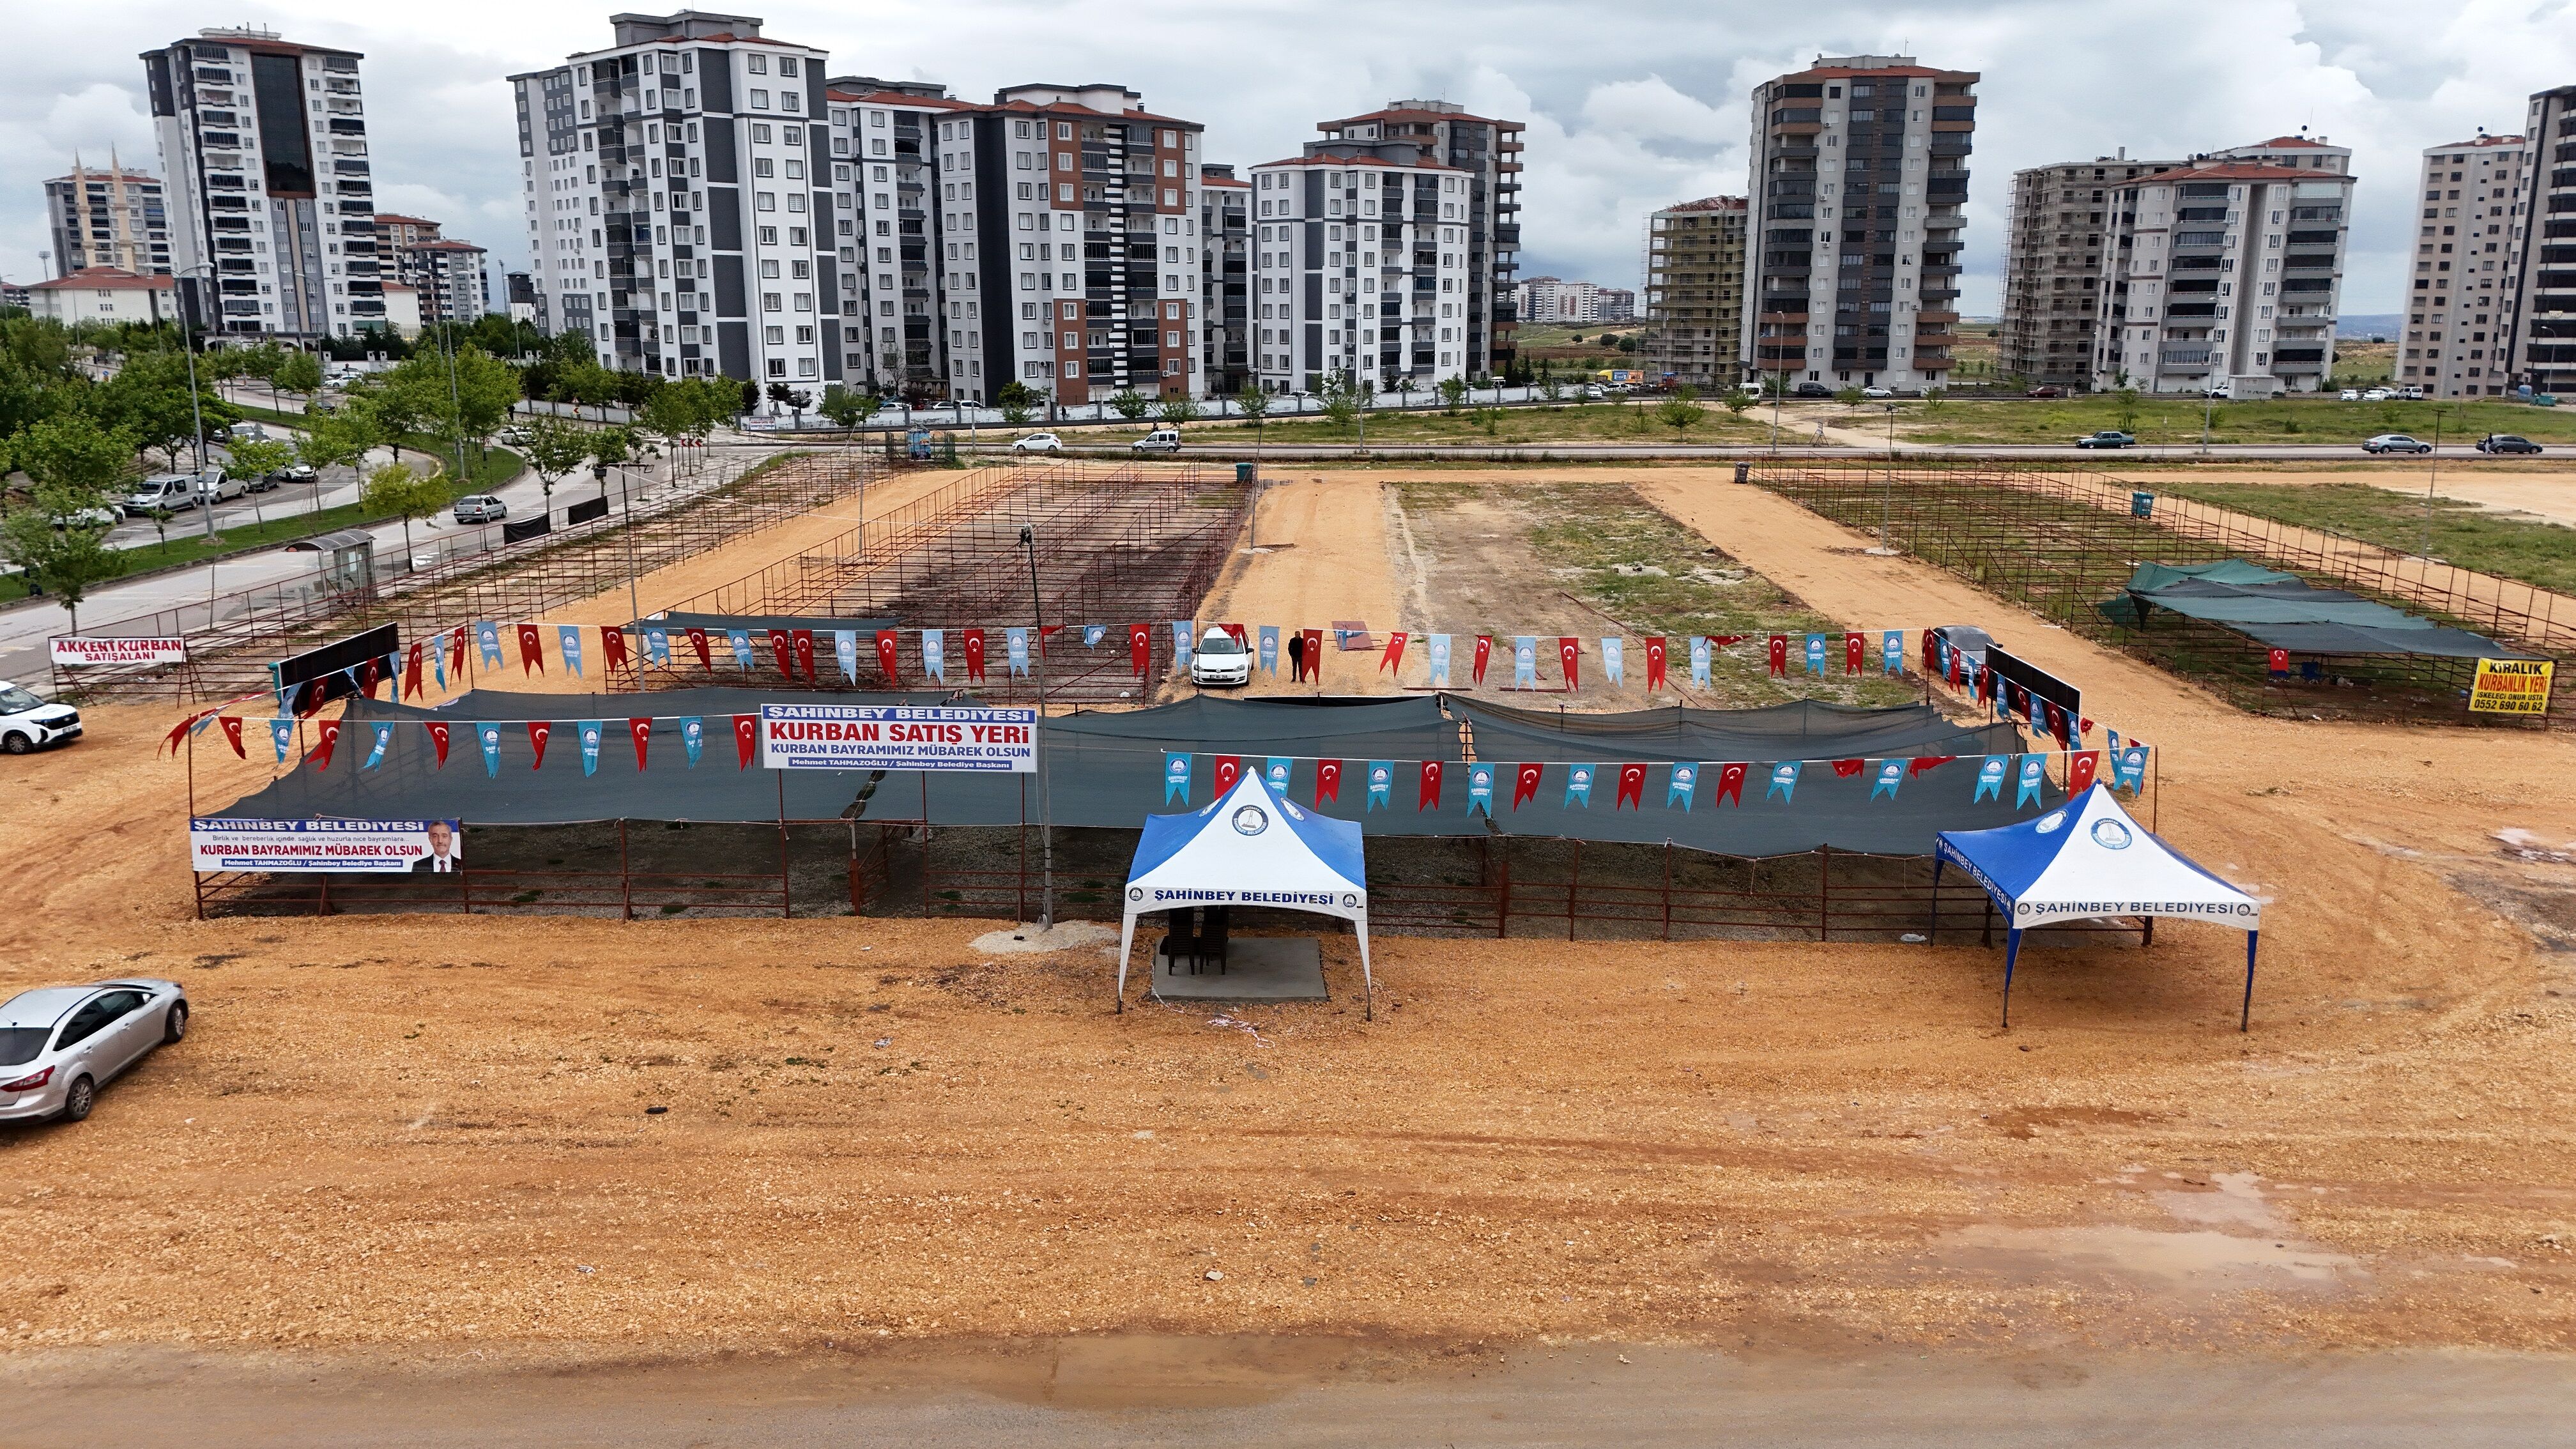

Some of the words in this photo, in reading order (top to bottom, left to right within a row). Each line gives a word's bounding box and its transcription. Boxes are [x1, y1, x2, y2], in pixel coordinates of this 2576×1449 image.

[56, 641, 115, 652] AKKENT
[118, 640, 181, 652] KURBAN
[2478, 673, 2527, 693] KURBANLIK
[2474, 699, 2497, 709] 0552
[2499, 701, 2516, 710] 690
[2518, 702, 2529, 710] 60
[2531, 702, 2543, 711] 62
[769, 707, 887, 718] ŞAHİNBEY
[896, 709, 1029, 721] BELEDİYESİ
[770, 722, 879, 740] KURBAN
[889, 724, 962, 744] SATIŞ
[969, 726, 1029, 743] YERİ
[771, 744, 827, 753] KURBAN
[831, 744, 914, 755] BAYRAMIMIZ
[918, 744, 983, 756] MÜBAREK
[986, 747, 1030, 757] OLSUN
[194, 820, 298, 831] ŞAHİNBEY
[305, 821, 424, 831] BELEDİYESİ
[201, 845, 249, 855] KURBAN
[252, 845, 322, 855] BAYRAMIMIZ
[325, 843, 381, 855] MÜBAREK
[385, 845, 422, 855] OLSUN
[1943, 842, 1972, 872] ŞAHİNBEY
[1154, 888, 1236, 901] ŞAHİNBEY
[1241, 891, 1333, 905] BELEDİYESİ
[2035, 900, 2125, 915] ŞAHİNBEY
[2129, 901, 2234, 914] BELEDİYESİ
